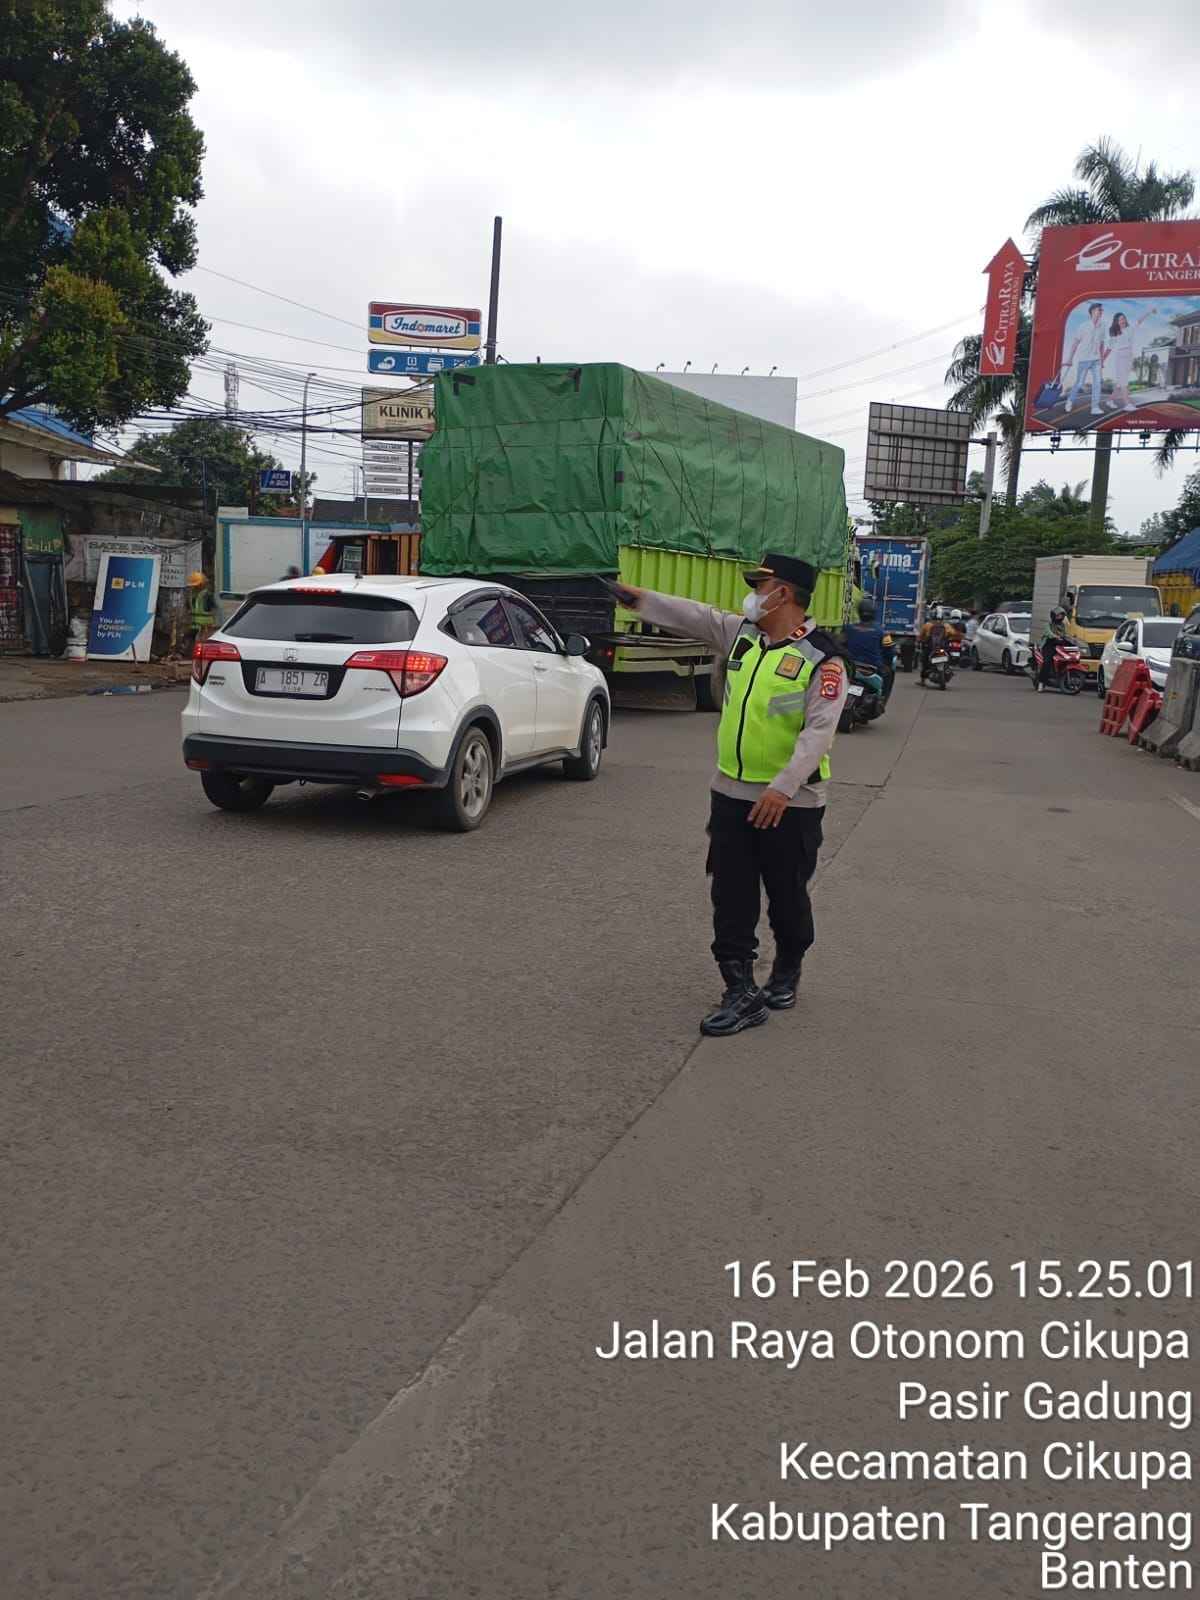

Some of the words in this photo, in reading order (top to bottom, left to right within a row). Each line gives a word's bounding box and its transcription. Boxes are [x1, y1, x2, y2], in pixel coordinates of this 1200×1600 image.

[1119, 248, 1200, 270] CITRA
[391, 316, 461, 335] Indomaret
[379, 405, 424, 419] KLINIK
[97, 631, 106, 639] by
[281, 671, 305, 686] 1851
[313, 672, 329, 688] ZR
